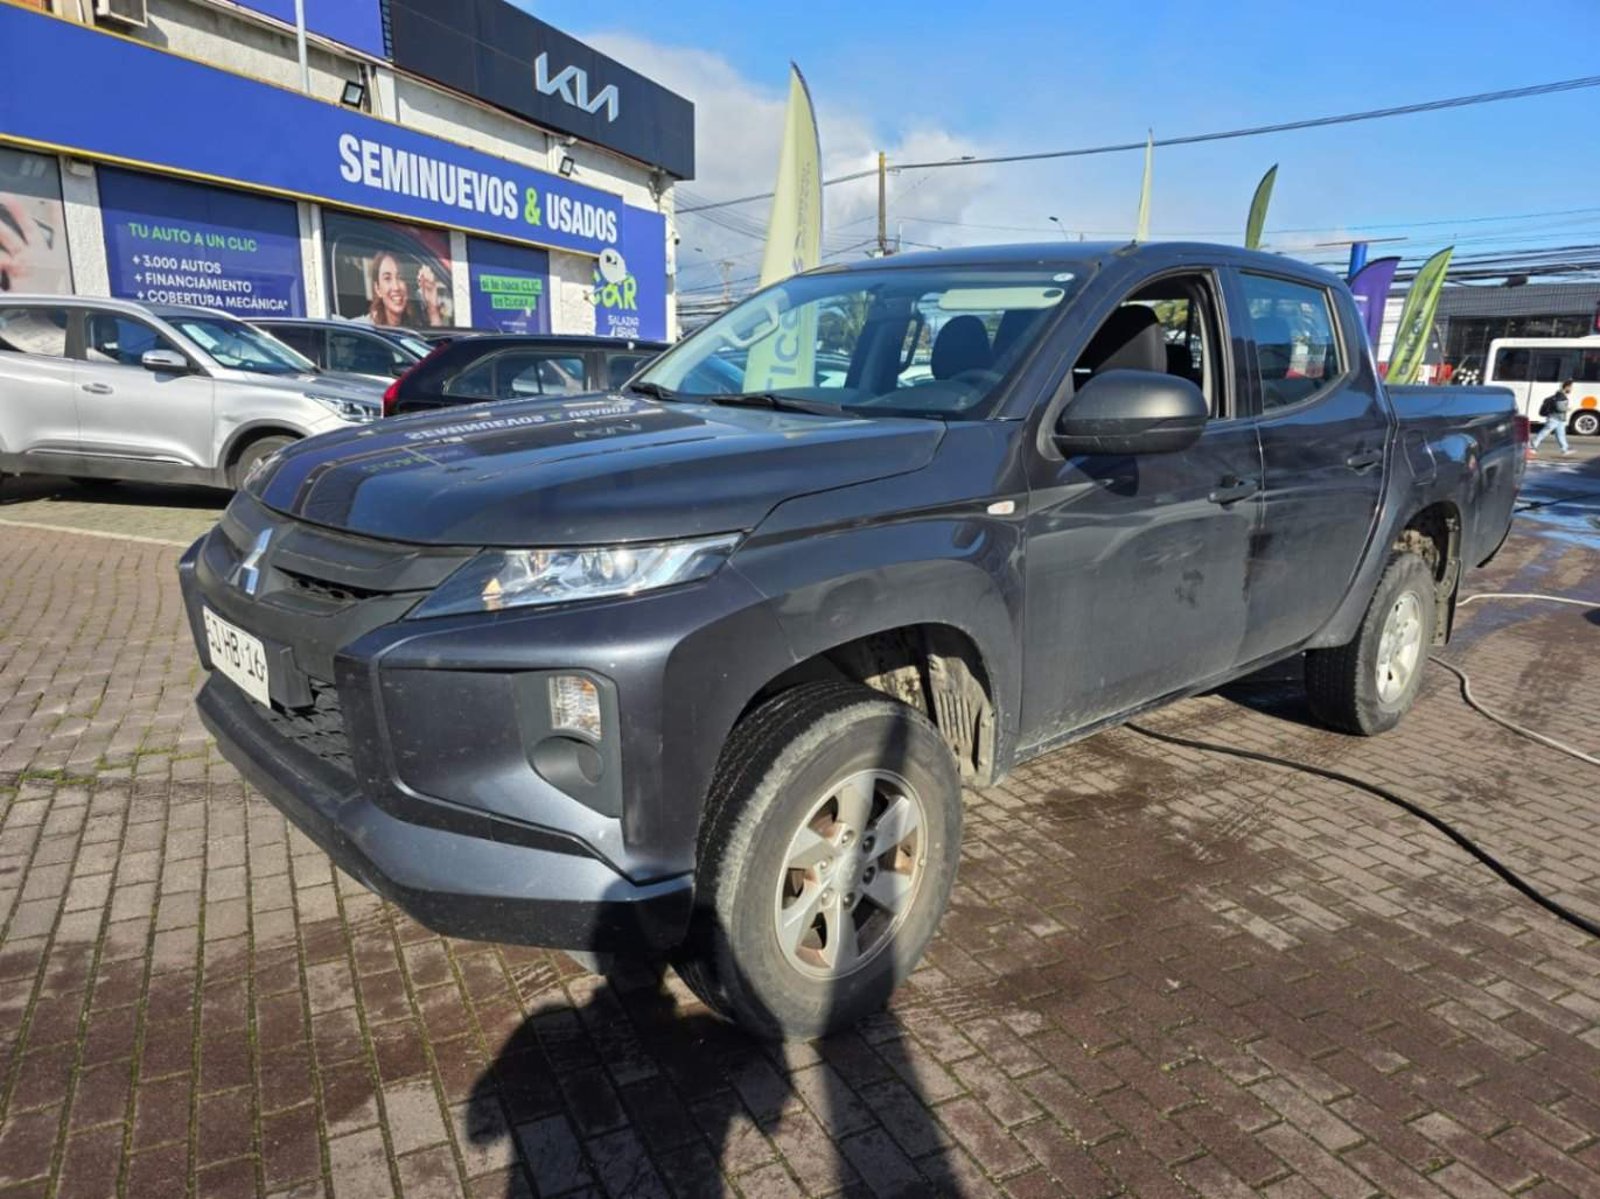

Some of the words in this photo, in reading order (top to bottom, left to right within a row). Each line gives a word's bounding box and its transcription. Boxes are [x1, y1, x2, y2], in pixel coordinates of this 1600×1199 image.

[339, 134, 518, 219] SEMINUEVOS
[524, 187, 541, 226] &
[546, 193, 617, 243] USADOS
[128, 223, 148, 238] TU
[152, 226, 191, 243] AUTO
[194, 233, 205, 246] A
[207, 234, 225, 248] UN
[228, 237, 257, 252] CLIC
[142, 255, 177, 269] 3.000
[181, 260, 222, 274] AUTOS
[145, 272, 253, 293] FINANCIAMIENTO
[147, 290, 224, 308] COBERTURA
